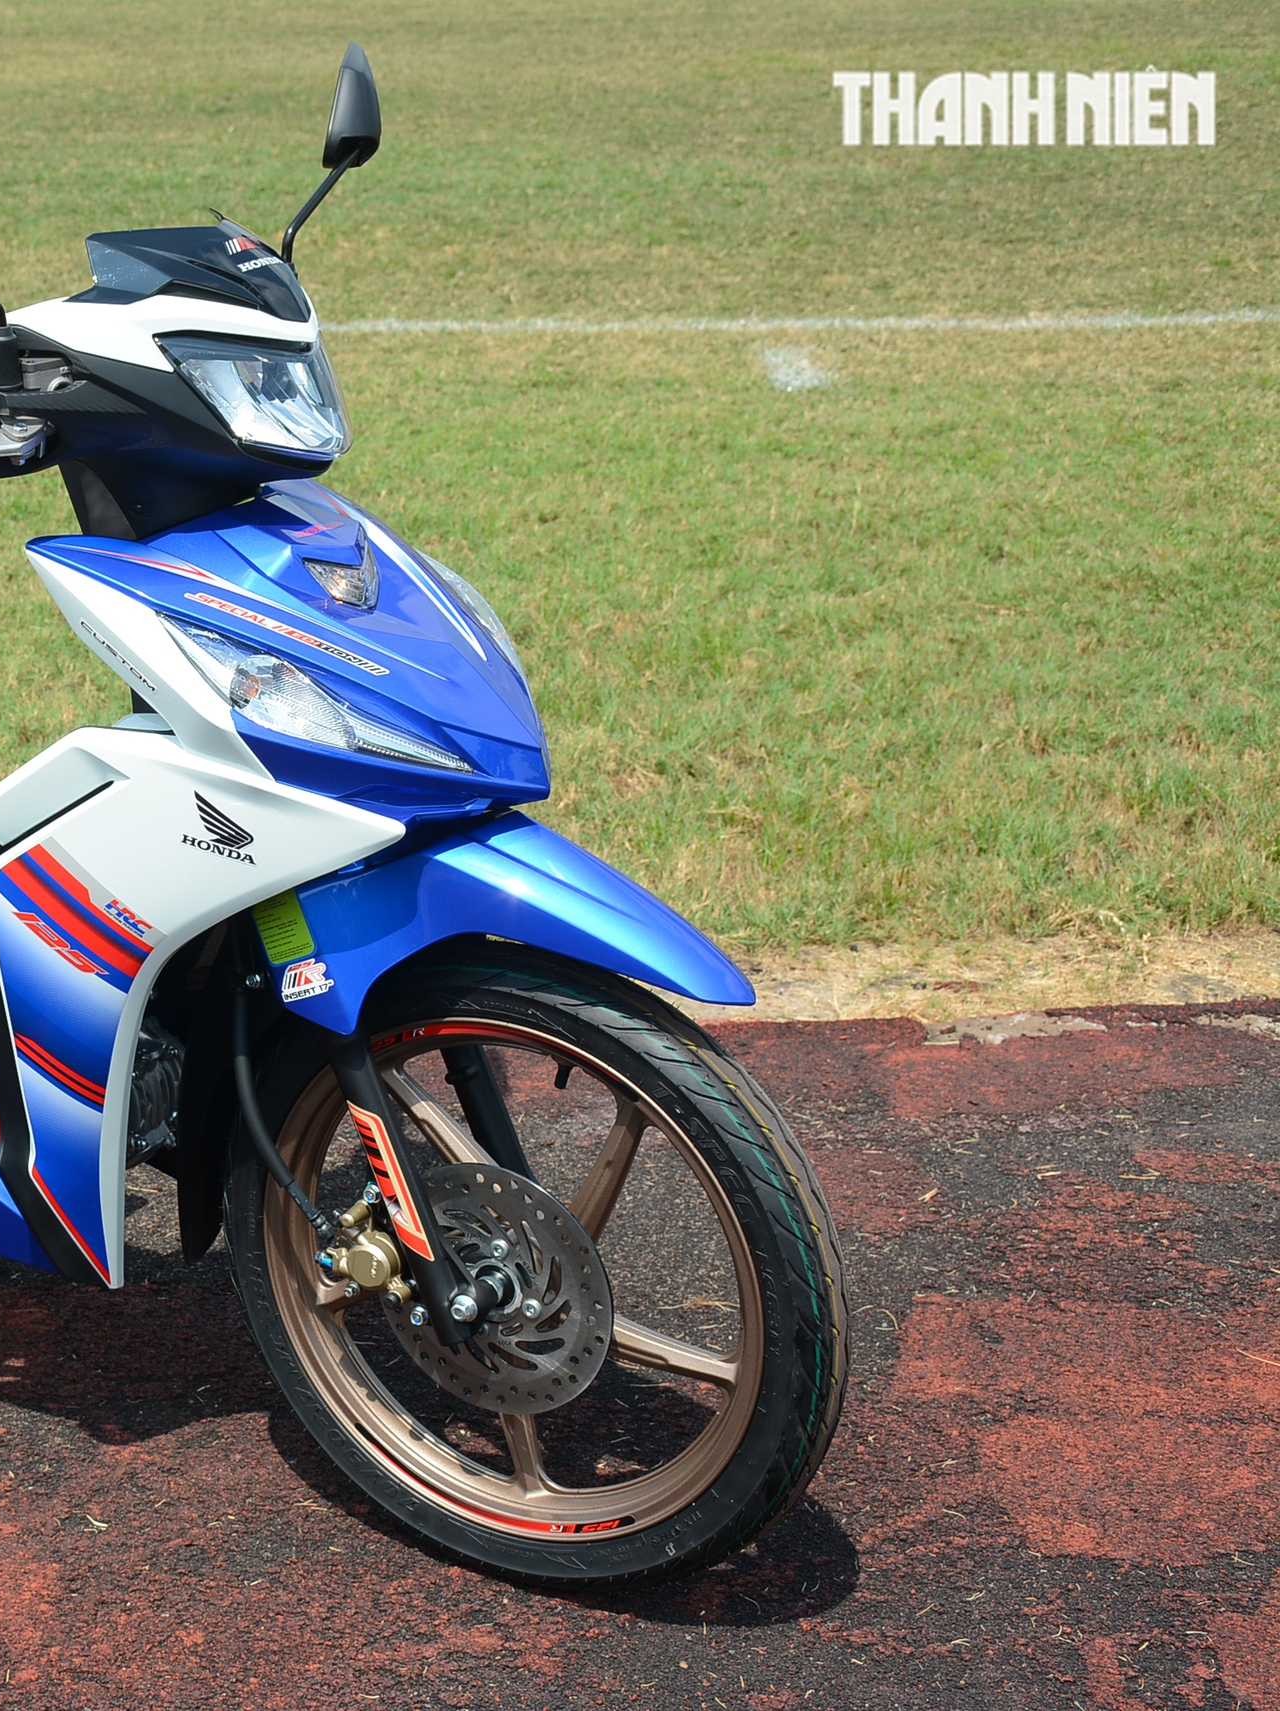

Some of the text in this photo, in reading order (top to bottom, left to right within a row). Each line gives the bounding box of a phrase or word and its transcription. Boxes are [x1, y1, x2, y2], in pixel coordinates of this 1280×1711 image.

[236, 256, 284, 273] HONDA
[187, 594, 365, 664] SPECIAL EDITION
[80, 621, 156, 692] CUSTOM
[180, 834, 257, 865] HONDA
[104, 898, 153, 935] HRC
[11, 911, 111, 974] 125
[283, 986, 316, 1001] INSERT
[371, 1033, 398, 1053] 25
[580, 1519, 621, 1533] 125
